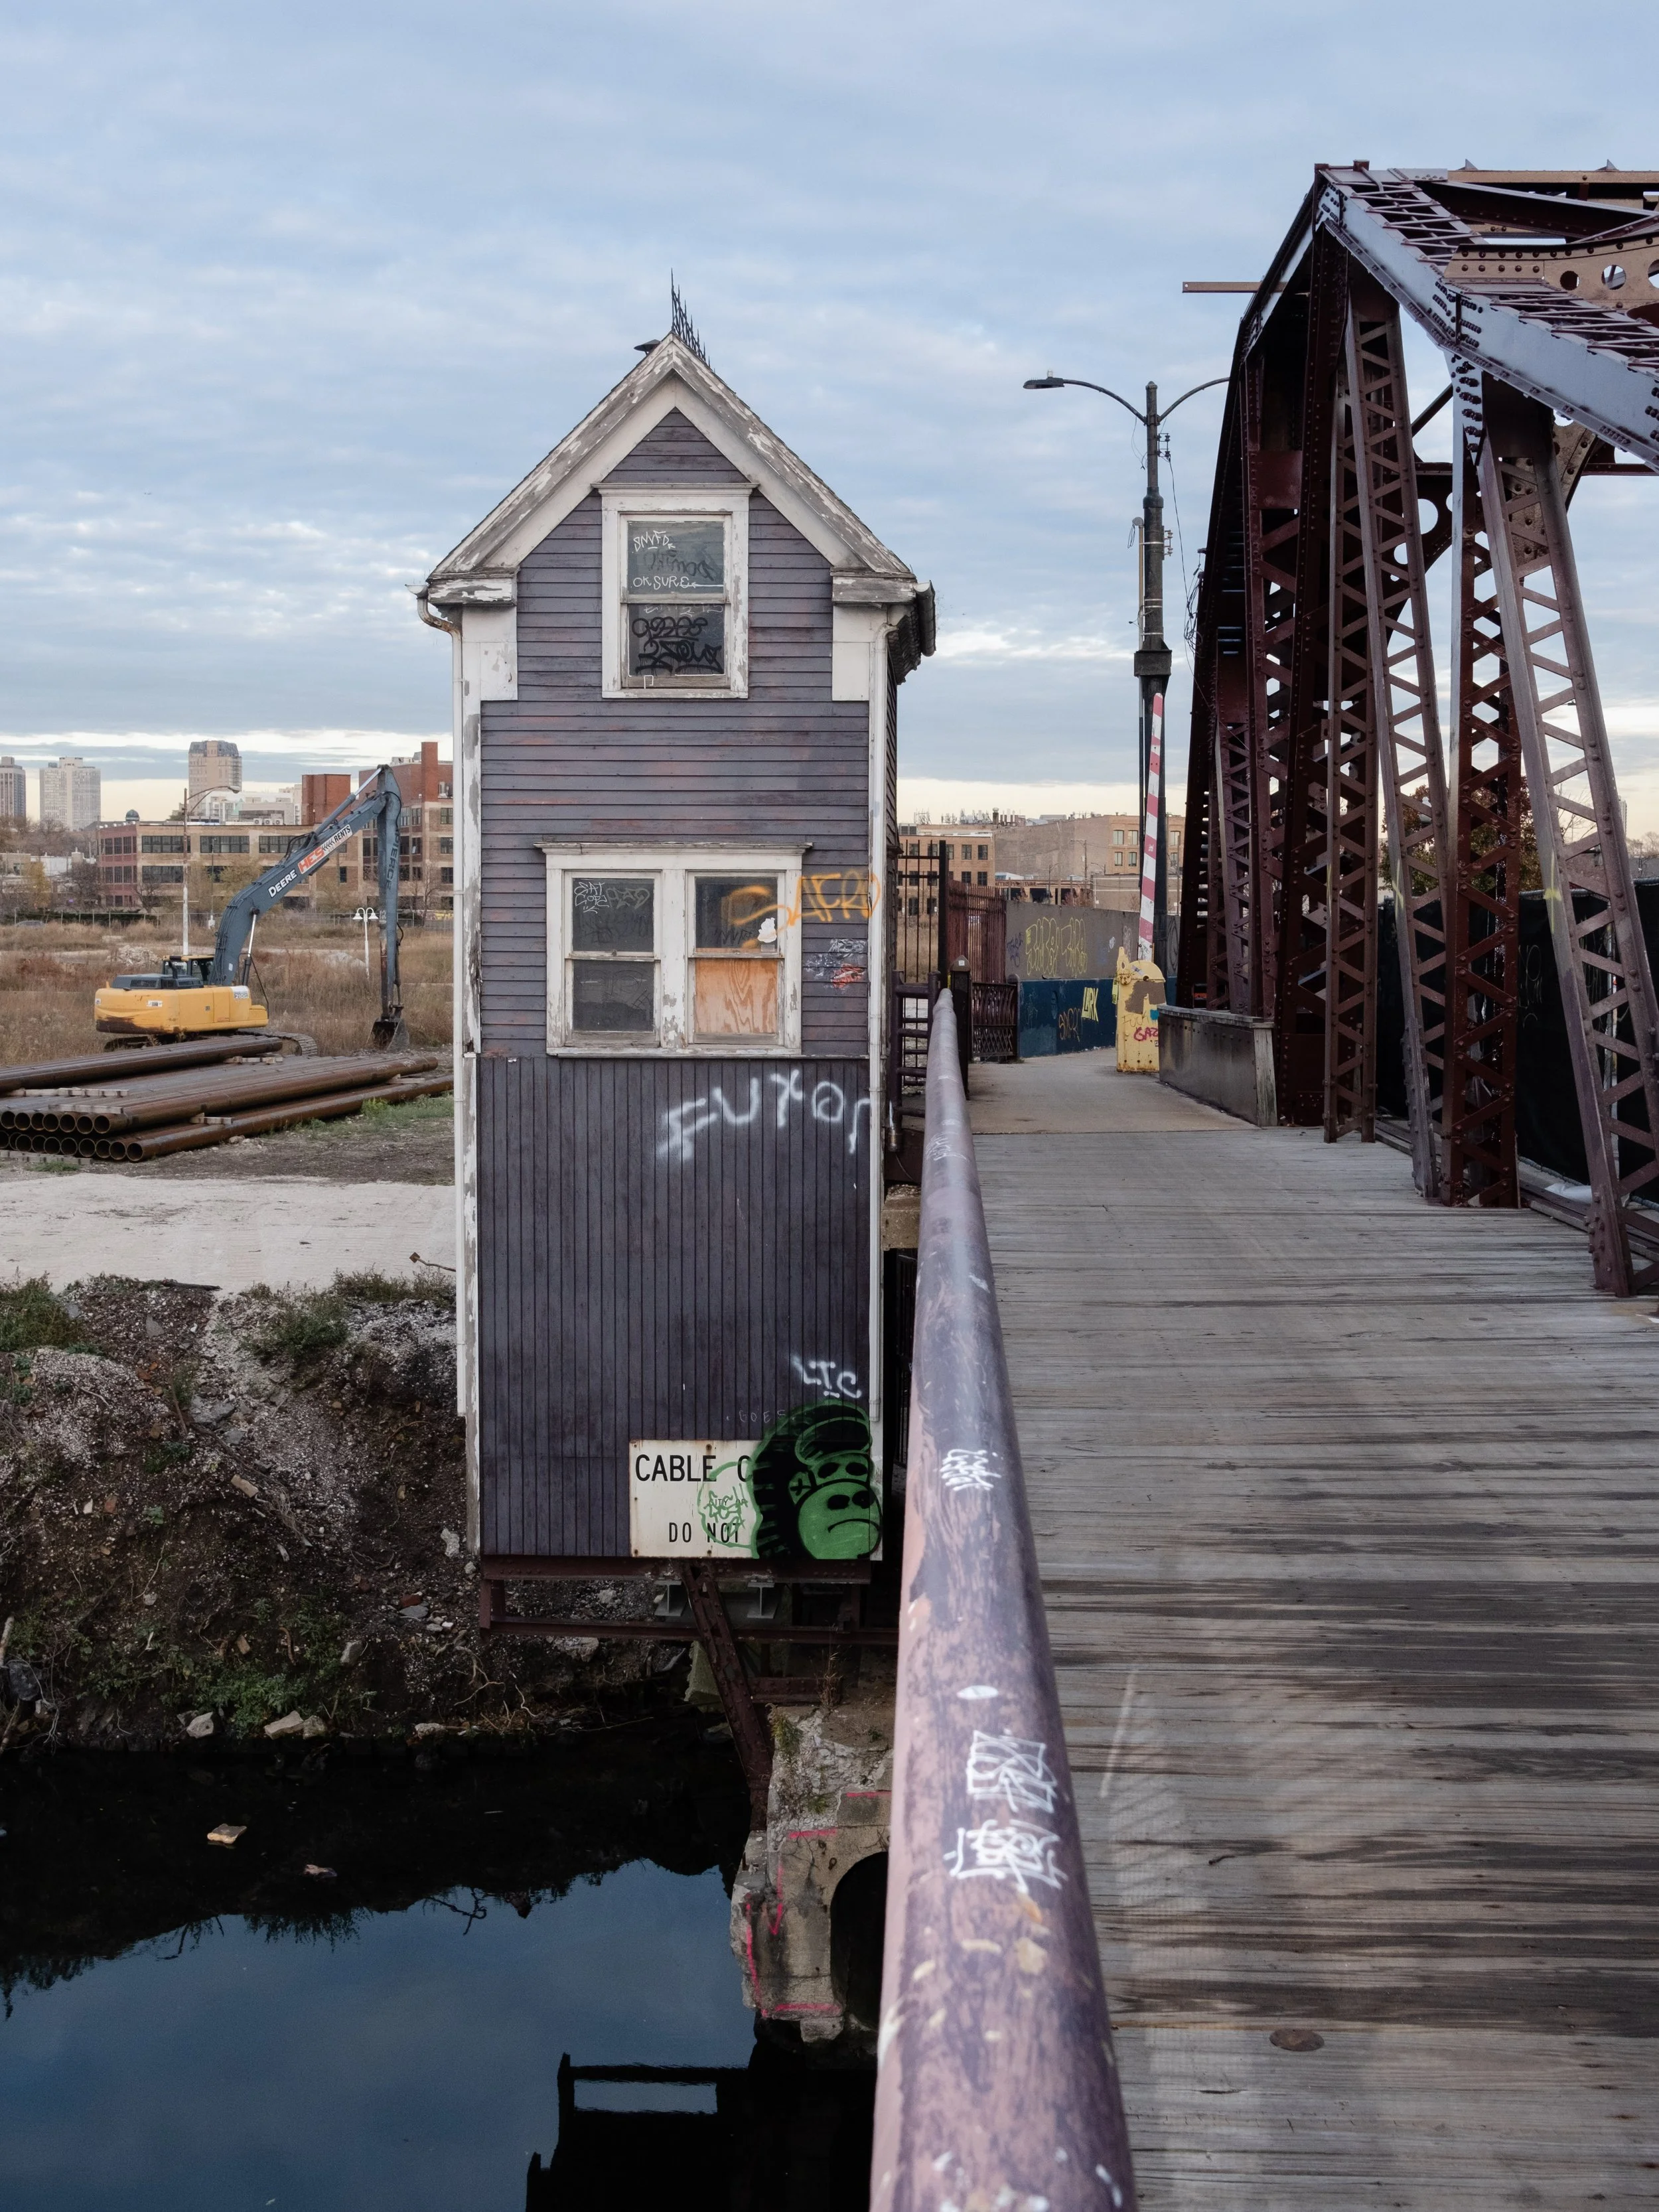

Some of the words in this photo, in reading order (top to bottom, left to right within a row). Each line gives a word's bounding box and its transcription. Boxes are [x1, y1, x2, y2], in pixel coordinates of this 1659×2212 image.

[633, 576, 652, 587] OK
[654, 575, 689, 590] SURE
[298, 846, 326, 873] HES
[333, 824, 352, 843] RENTS
[268, 869, 297, 897] DEERE
[635, 1454, 717, 1482] CABLE
[668, 1522, 692, 1542] DO
[707, 1522, 740, 1543] NOT
